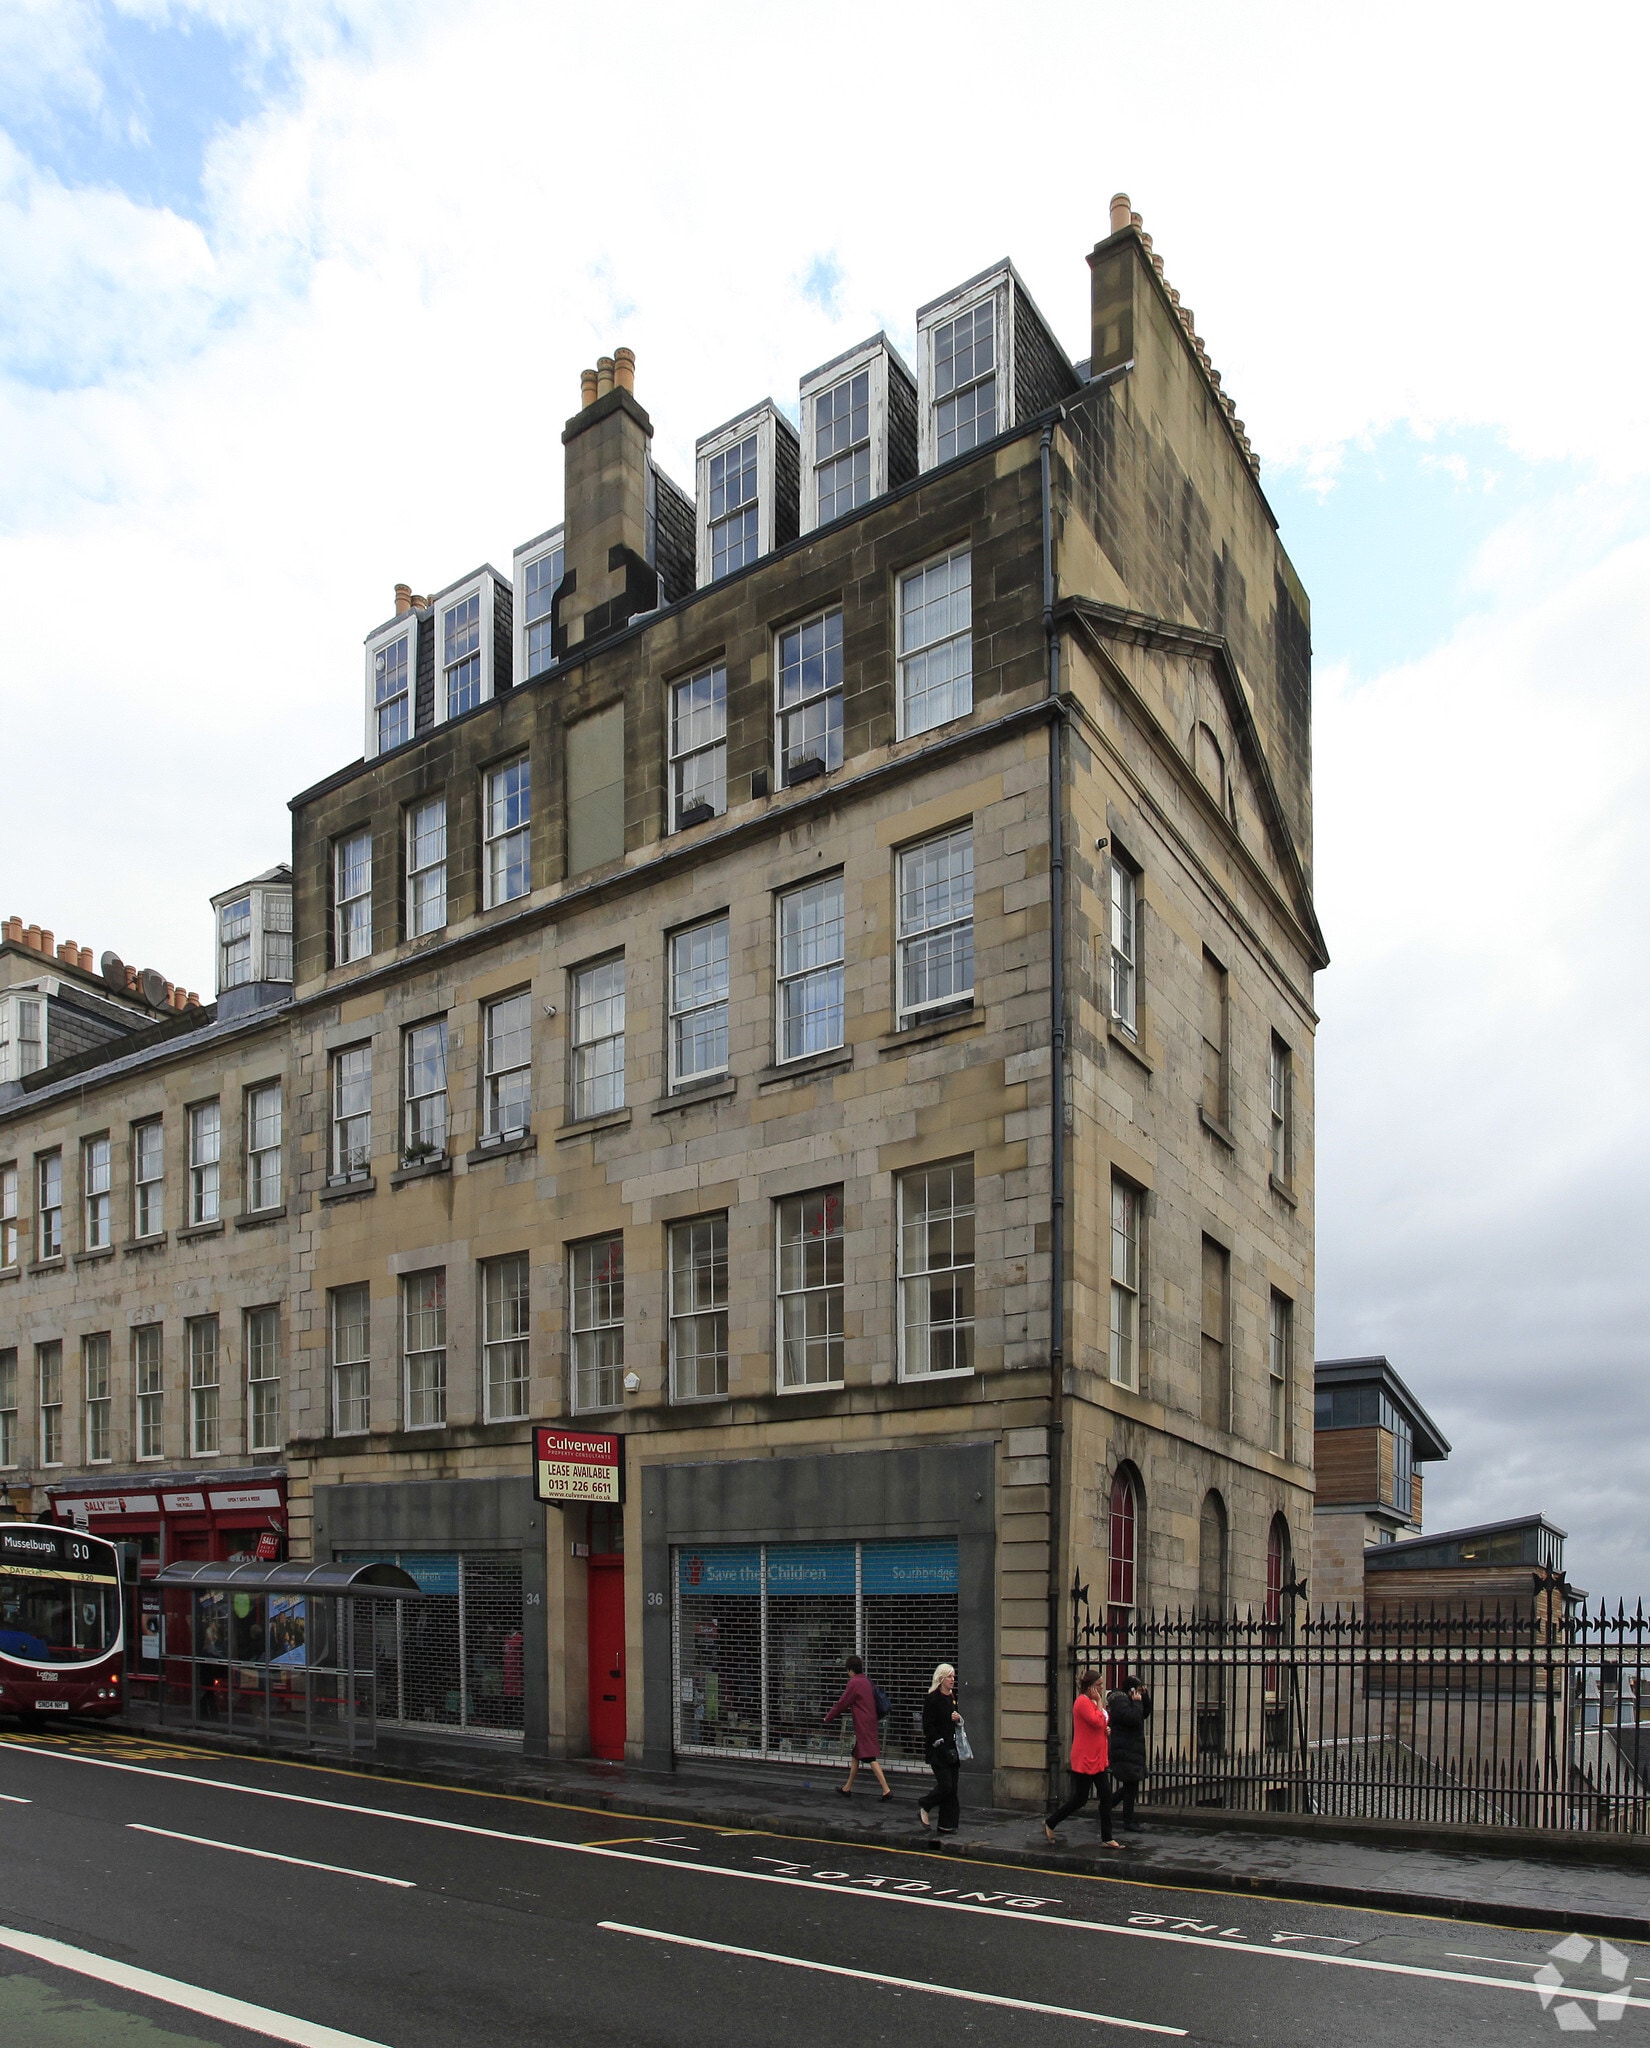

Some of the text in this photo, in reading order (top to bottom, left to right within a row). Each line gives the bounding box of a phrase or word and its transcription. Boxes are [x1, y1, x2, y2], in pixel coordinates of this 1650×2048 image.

[547, 1436, 611, 1454] Culverwell
[547, 1449, 611, 1460] PROPERTY CONSULTANTS
[547, 1463, 610, 1479] LEASE AVAILABLE
[548, 1479, 611, 1493] 0131 226 6611
[548, 1491, 611, 1500] www.culverwell.co.uk
[84, 1501, 106, 1512] SALLY
[261, 1536, 279, 1545] SALLY
[4, 1536, 89, 1560] Musselburgh 30
[706, 1563, 956, 1582] Save the Children Southbridge
[526, 1592, 663, 1606] 34 36
[774, 1866, 1307, 1943] LOADING ONLY
